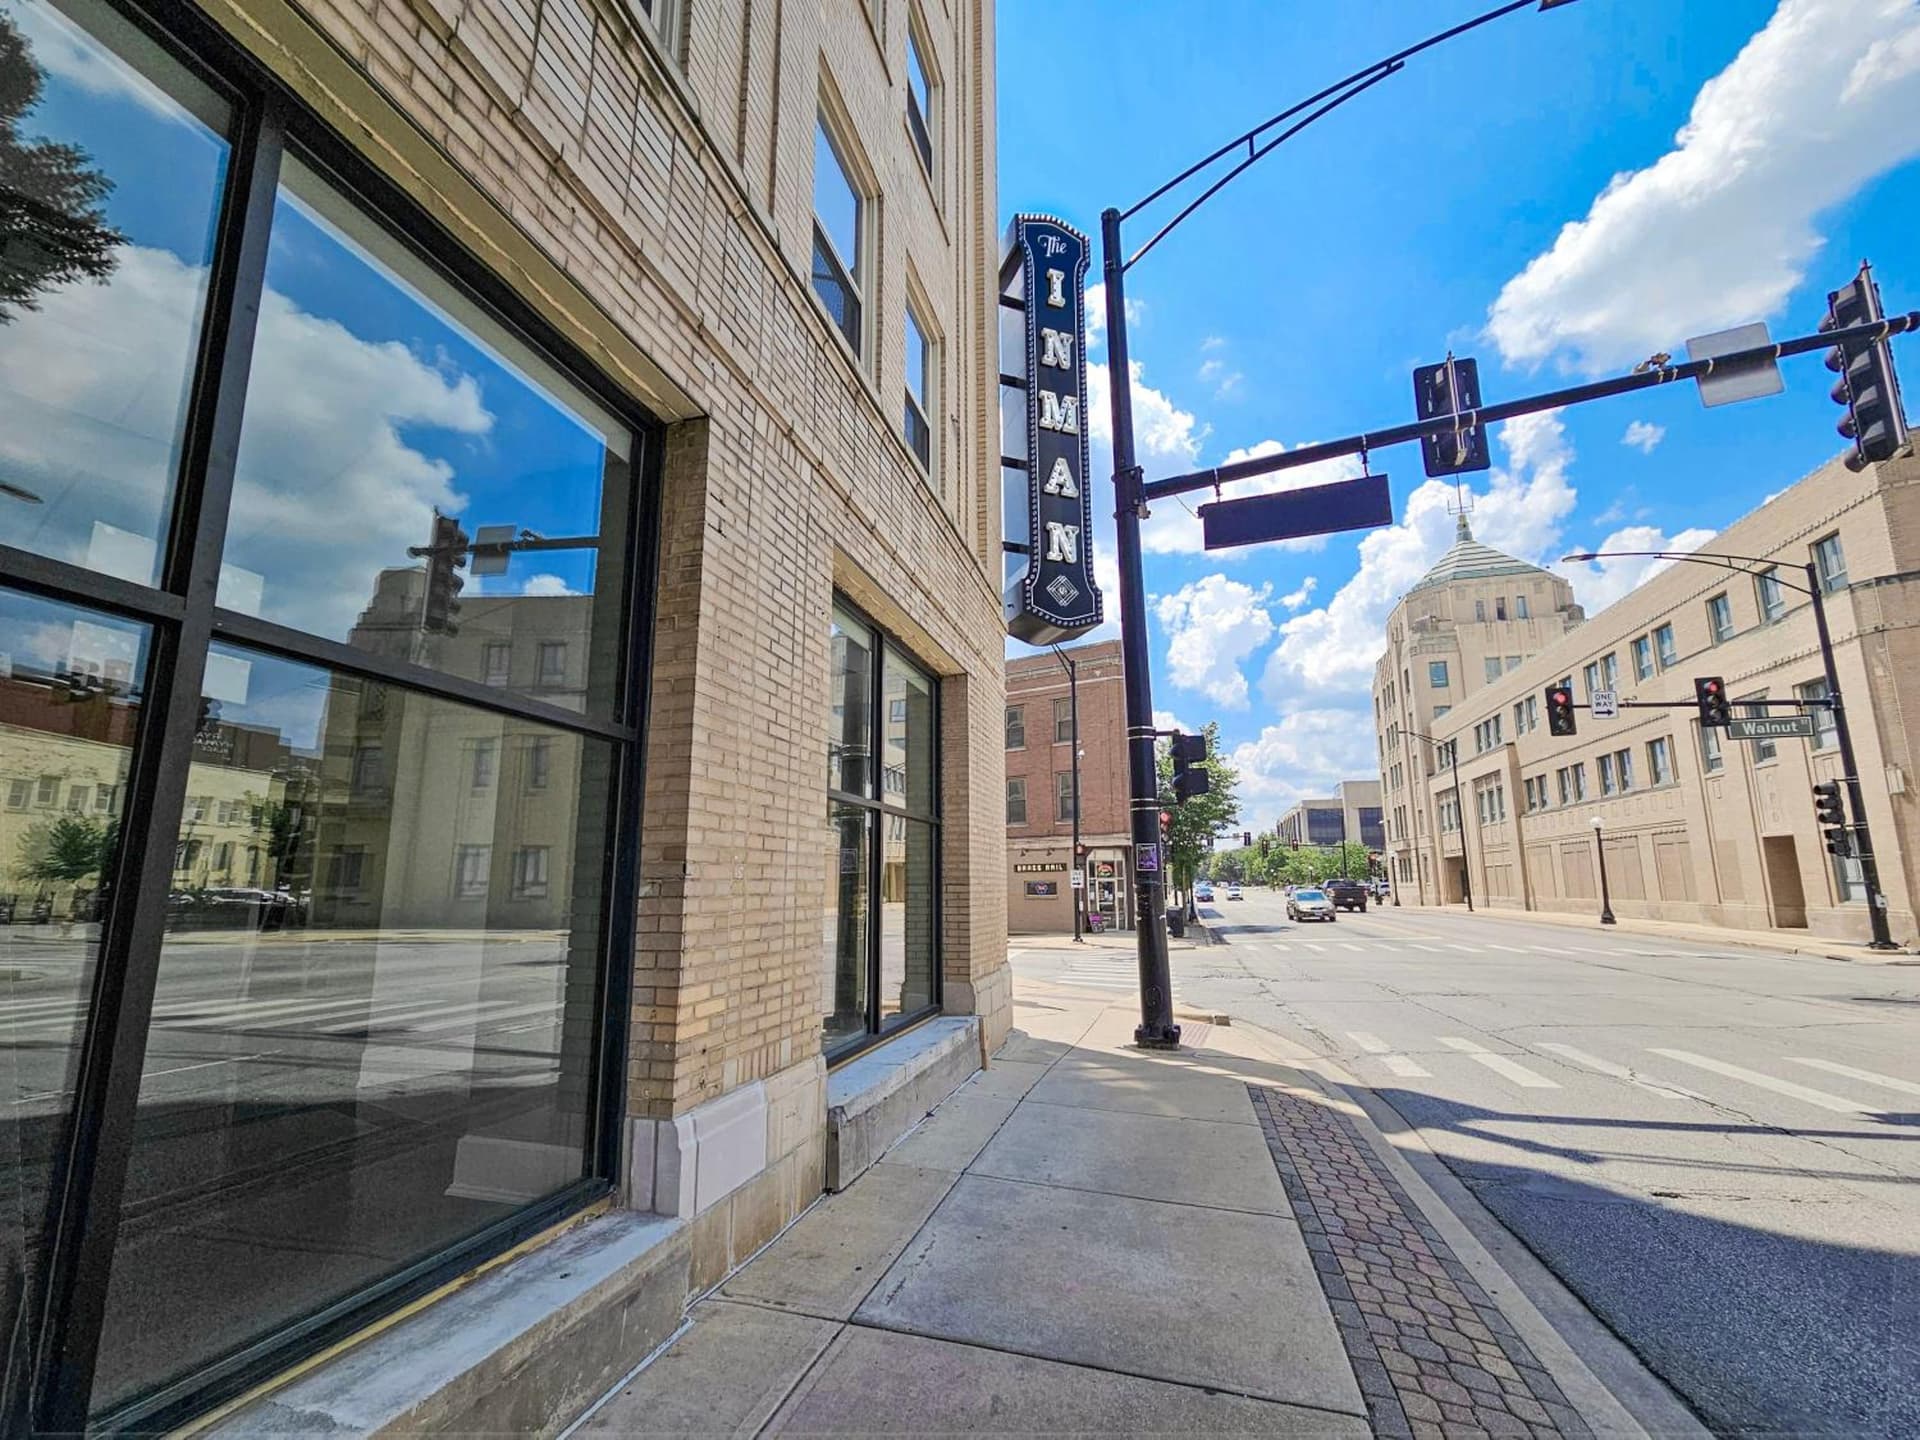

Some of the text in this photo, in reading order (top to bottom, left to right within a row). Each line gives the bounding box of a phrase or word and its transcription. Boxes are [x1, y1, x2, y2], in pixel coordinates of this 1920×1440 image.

[1038, 235, 1067, 257] The
[1040, 267, 1079, 563] INMAN
[1595, 693, 1612, 701] ONE
[1742, 721, 1799, 735] Walnut
